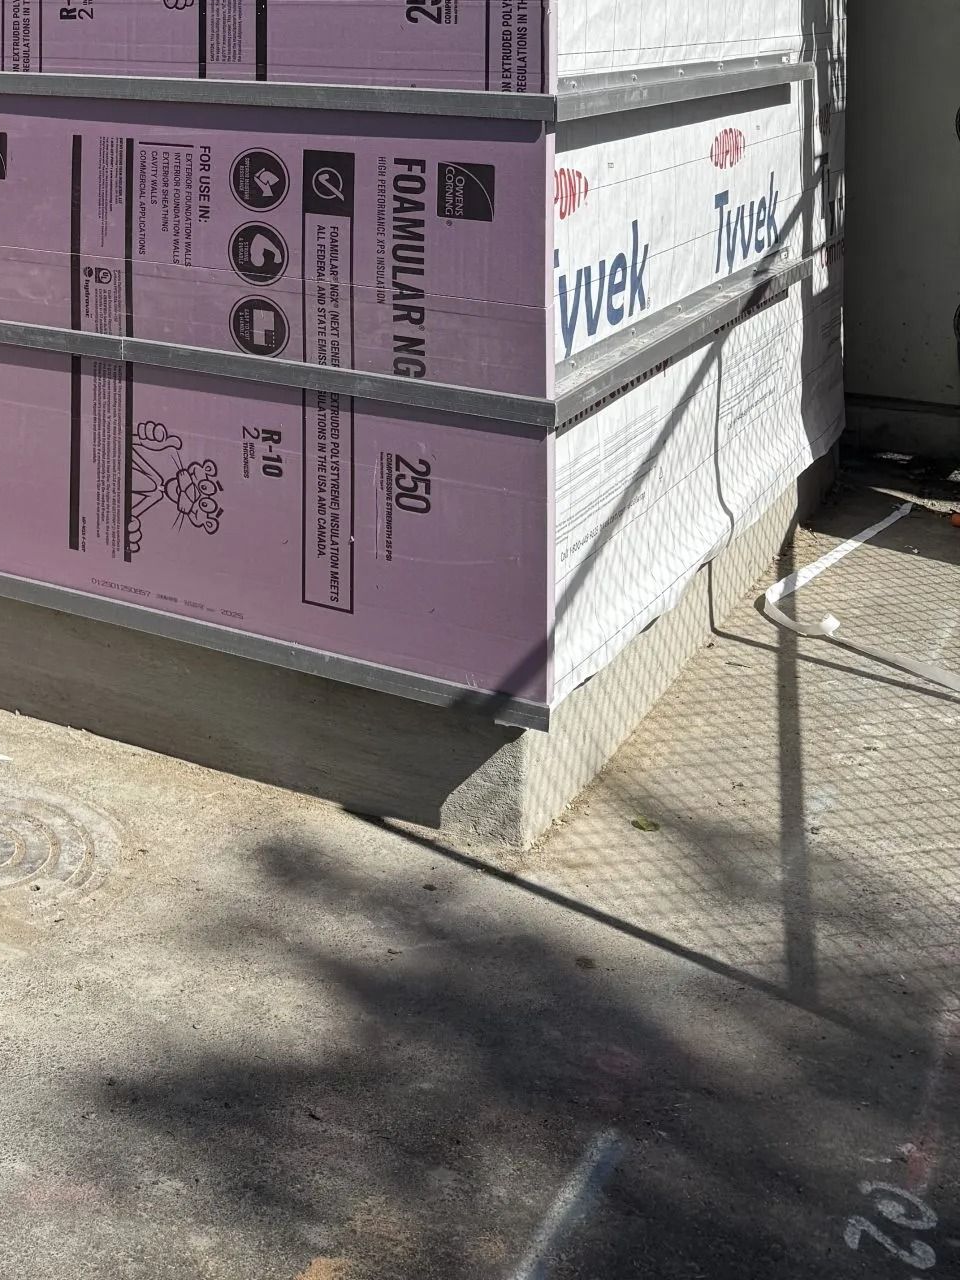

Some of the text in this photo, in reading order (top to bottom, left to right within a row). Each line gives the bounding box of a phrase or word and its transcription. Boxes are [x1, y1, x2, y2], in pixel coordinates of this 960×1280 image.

[22, 7, 31, 17] IN
[517, 13, 528, 24] IN
[12, 21, 21, 62] EXTRUDED
[501, 29, 513, 79] EXTRUDED
[516, 26, 528, 94] REGULATIONS
[173, 152, 181, 187] INTERIOR
[715, 127, 743, 170] DUPONT
[139, 150, 147, 200] COMMERCIAL
[150, 179, 158, 205] WALLS
[161, 151, 170, 232] EXTERIOR SHEATHING
[198, 145, 211, 223] FOR USE IN:
[445, 166, 455, 215] CORNING
[456, 177, 465, 216] OWENS
[173, 188, 181, 237] FOUNDATION
[184, 190, 192, 239] FOUNDATION
[375, 155, 387, 305] HIGH PERFORMANCE XPS INSULATION
[714, 170, 779, 277] Tyvek
[184, 241, 192, 267] WALLS
[316, 224, 327, 336] ALL AND STATE
[328, 309, 340, 338] (NEXT
[393, 334, 427, 378] NG
[261, 429, 284, 479] R-10
[317, 441, 327, 560] IN THE USA AND CANADA.
[385, 452, 393, 561] COMPRESSIVE STRENGTH PSI
[394, 453, 431, 515] 250
[329, 440, 340, 602] POLYSTYRENE) INSULATION MEETS
